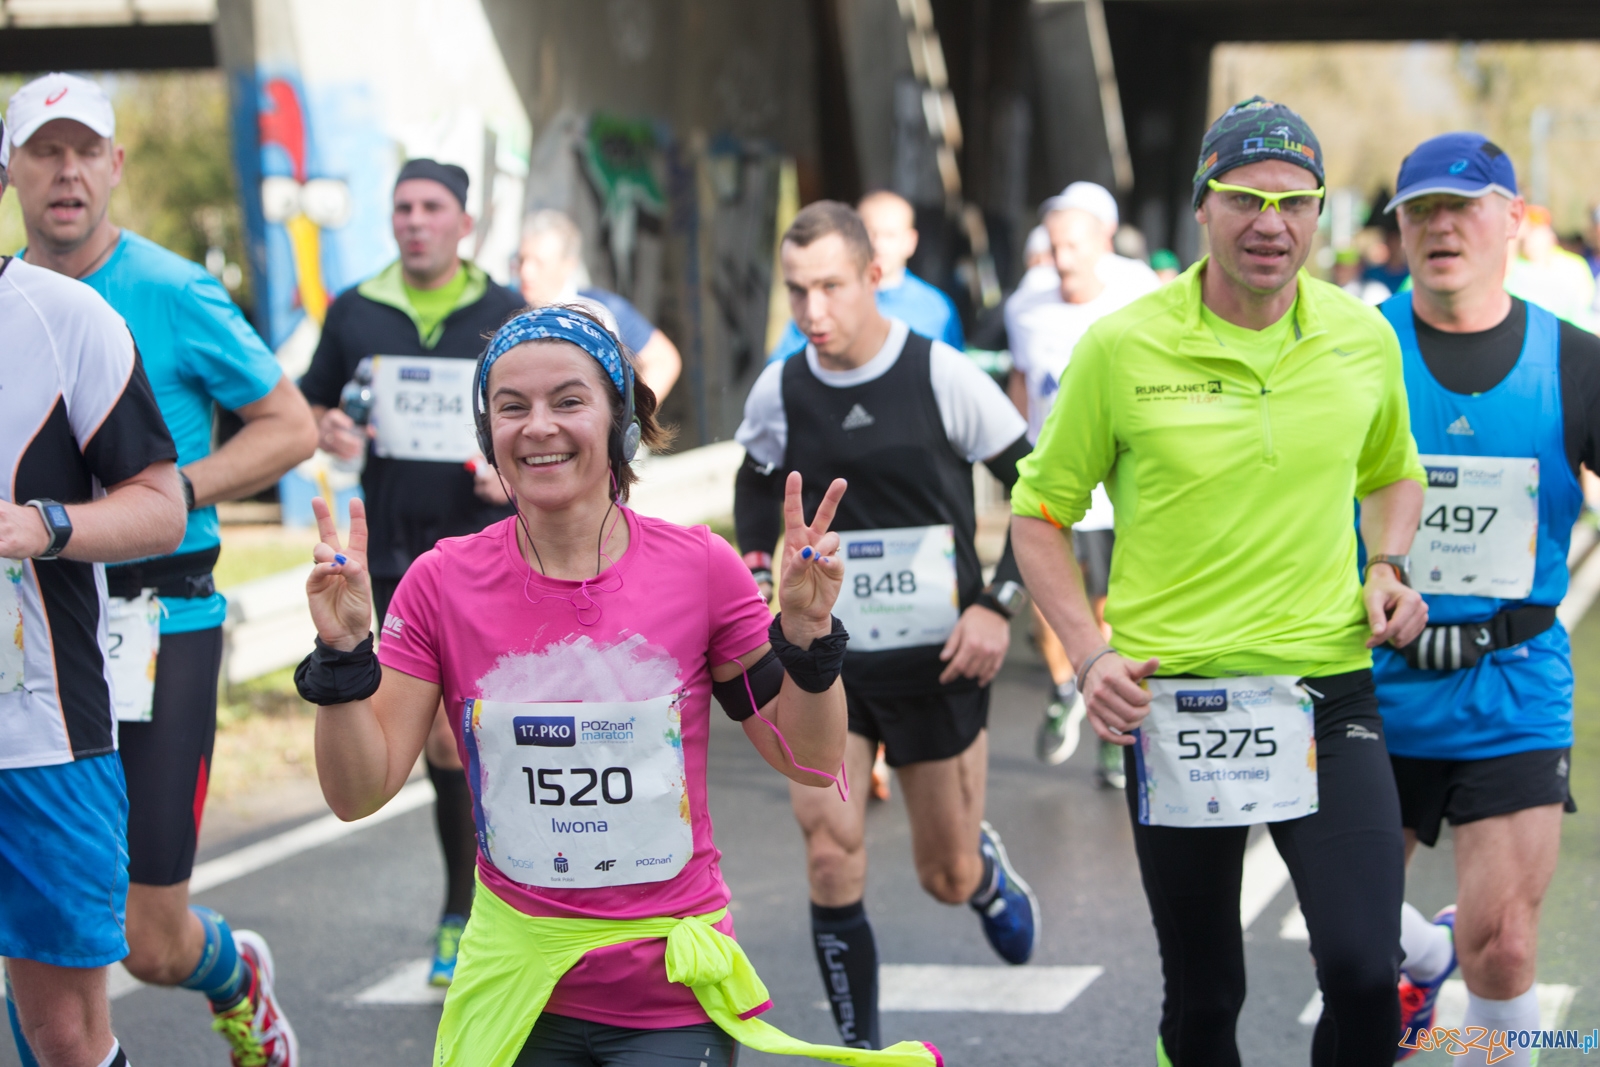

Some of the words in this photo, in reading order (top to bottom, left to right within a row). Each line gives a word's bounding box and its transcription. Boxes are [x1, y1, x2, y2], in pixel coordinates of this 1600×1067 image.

[1416, 504, 1498, 534] 497
[854, 570, 917, 598] 848
[581, 730, 634, 741] maraton
[1178, 727, 1277, 760] 5275
[522, 766, 633, 806] 1520
[551, 818, 609, 833] Iwona
[594, 859, 617, 871] 4F
